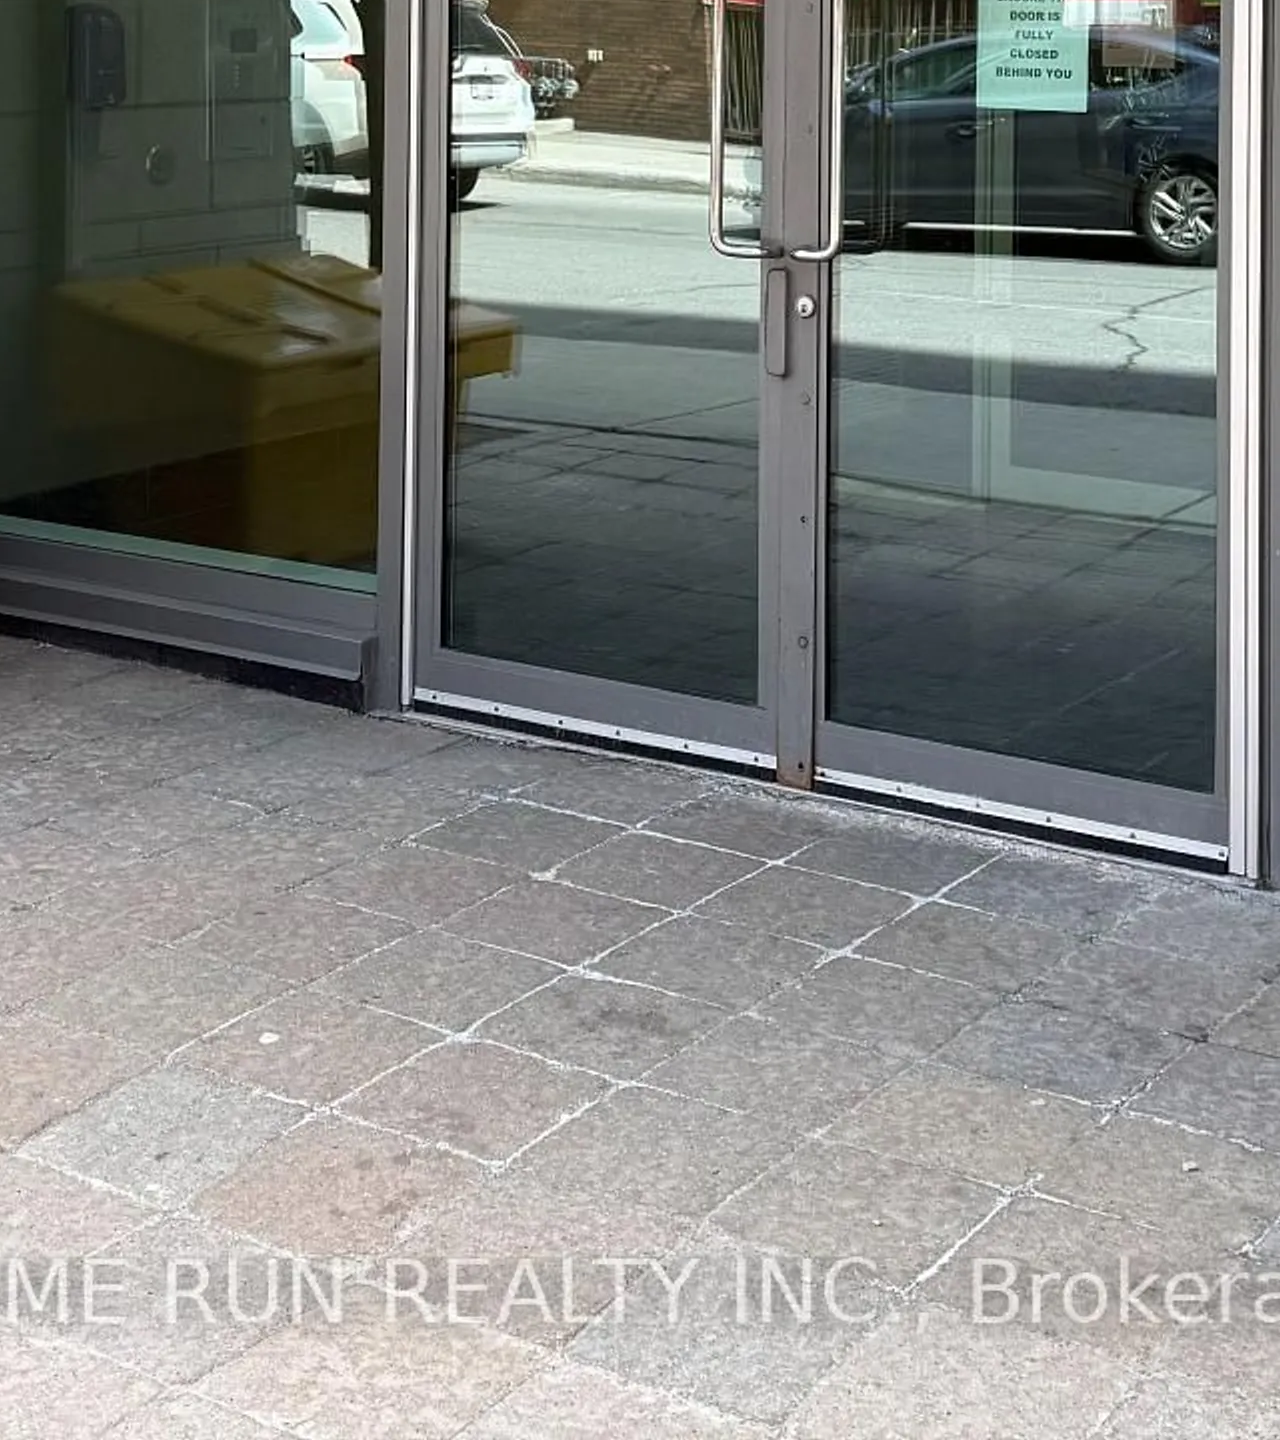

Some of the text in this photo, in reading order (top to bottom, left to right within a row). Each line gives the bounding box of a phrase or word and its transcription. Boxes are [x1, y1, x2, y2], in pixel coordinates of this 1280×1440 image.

[1009, 11, 1061, 22] DOOR IS
[1015, 30, 1054, 40] FULLY
[1009, 49, 1059, 60] CLOSED
[995, 66, 1073, 79] BEHIND YOU
